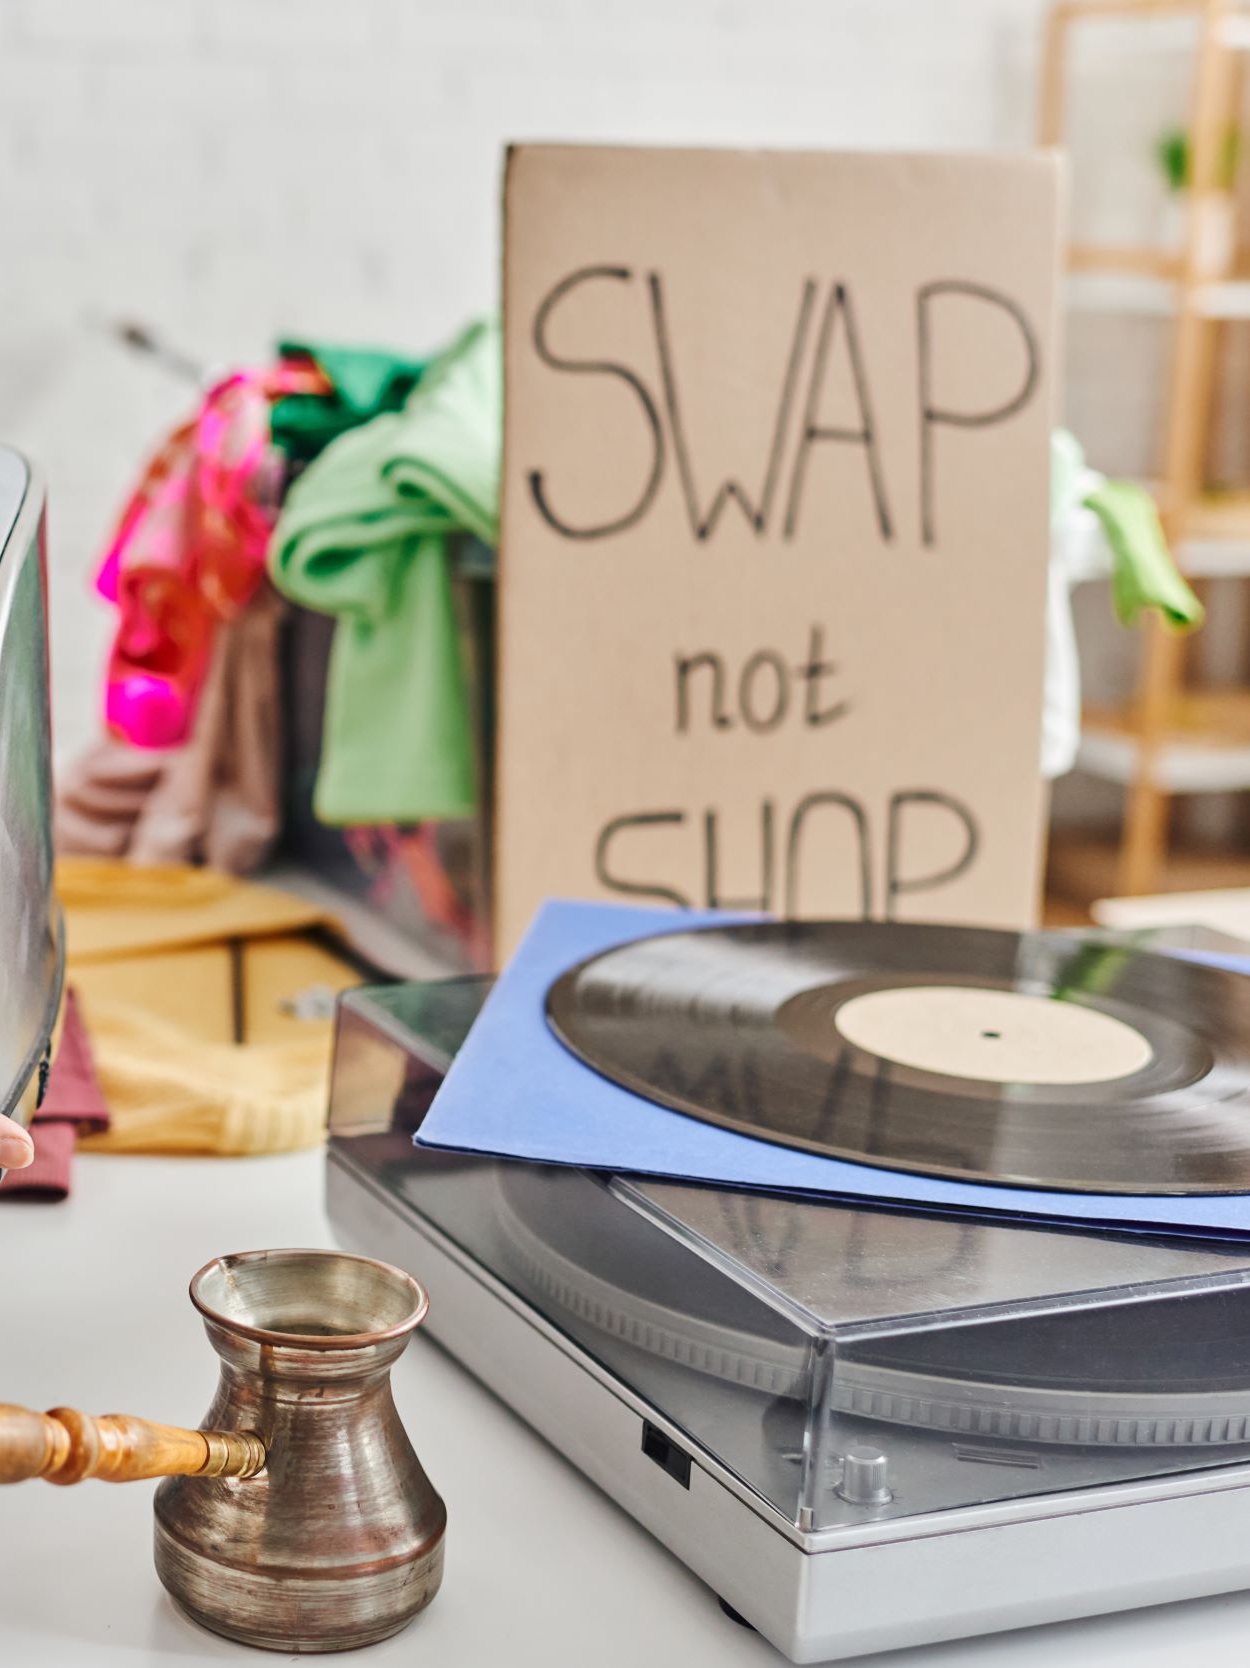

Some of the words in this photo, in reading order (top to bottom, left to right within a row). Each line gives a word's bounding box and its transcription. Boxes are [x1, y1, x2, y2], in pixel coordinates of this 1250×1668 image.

[527, 264, 1040, 547] SWAP
[674, 624, 852, 735] not
[595, 791, 981, 921] SHOP
